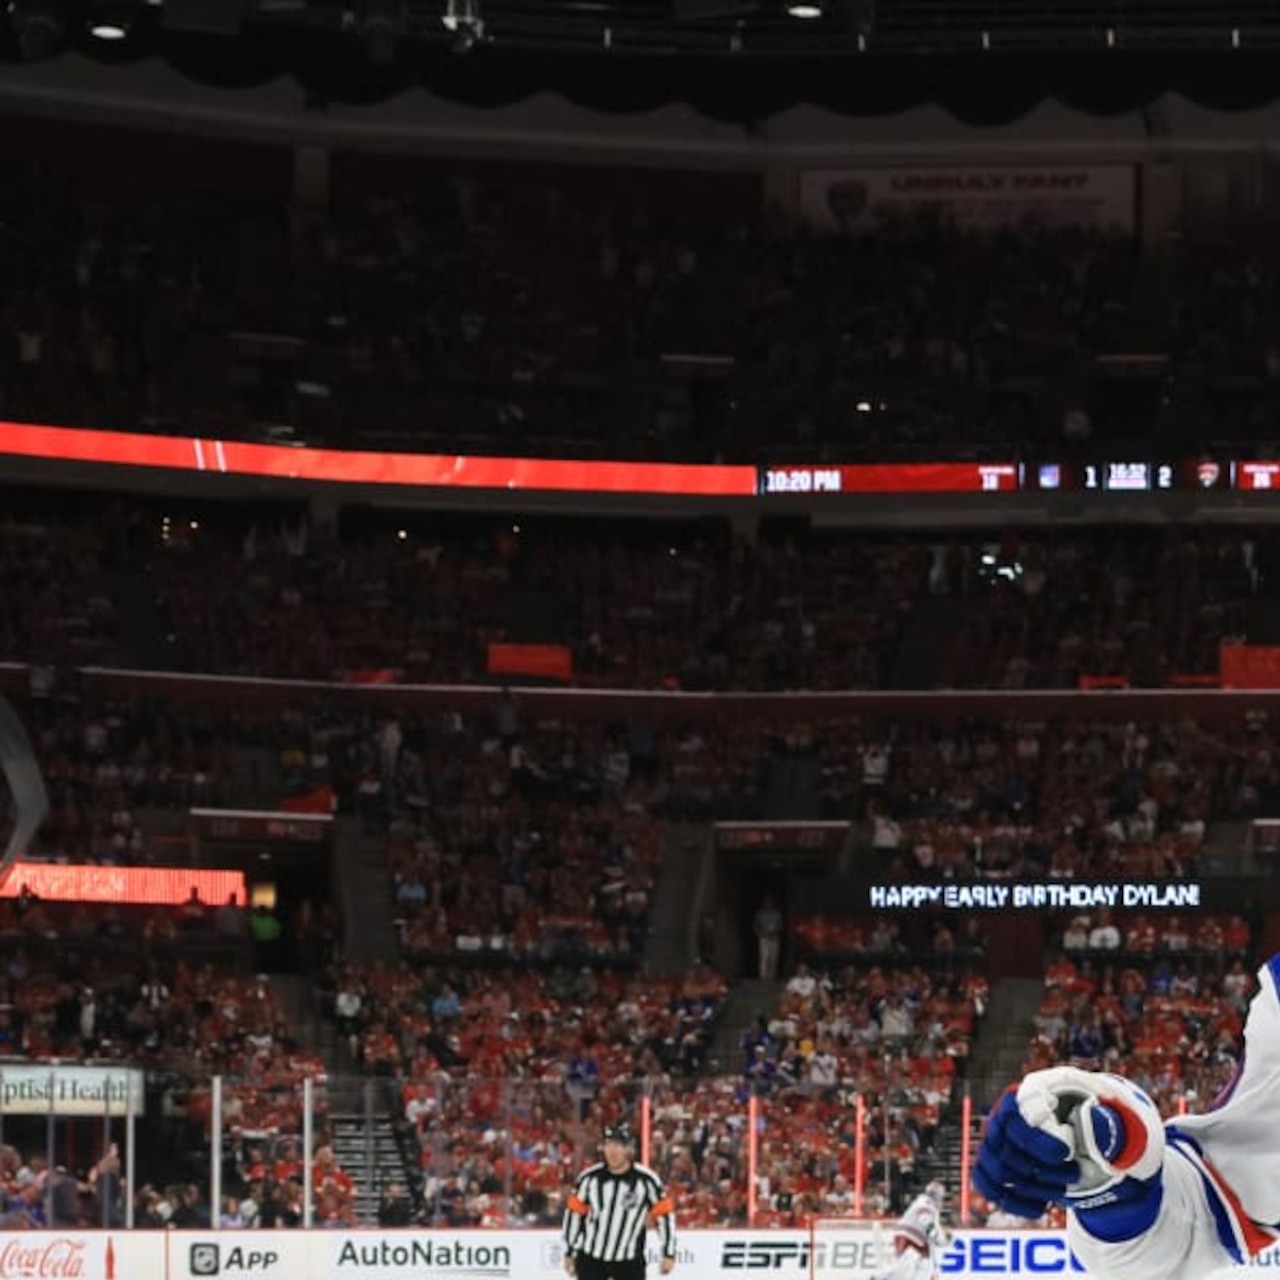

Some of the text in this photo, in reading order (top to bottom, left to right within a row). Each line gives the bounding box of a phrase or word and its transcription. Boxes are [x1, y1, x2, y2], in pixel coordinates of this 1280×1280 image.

[766, 470, 841, 491] 10:20 PM
[1084, 466, 1098, 488] 1
[870, 886, 942, 907] HAPPY
[944, 886, 1008, 907] EARLY
[1013, 886, 1118, 907] BIRTHDAY
[337, 1239, 510, 1267] AutoNation
[720, 1241, 825, 1269] ESPN
[831, 1241, 882, 1269] BE
[939, 1239, 1086, 1273] GEIC
